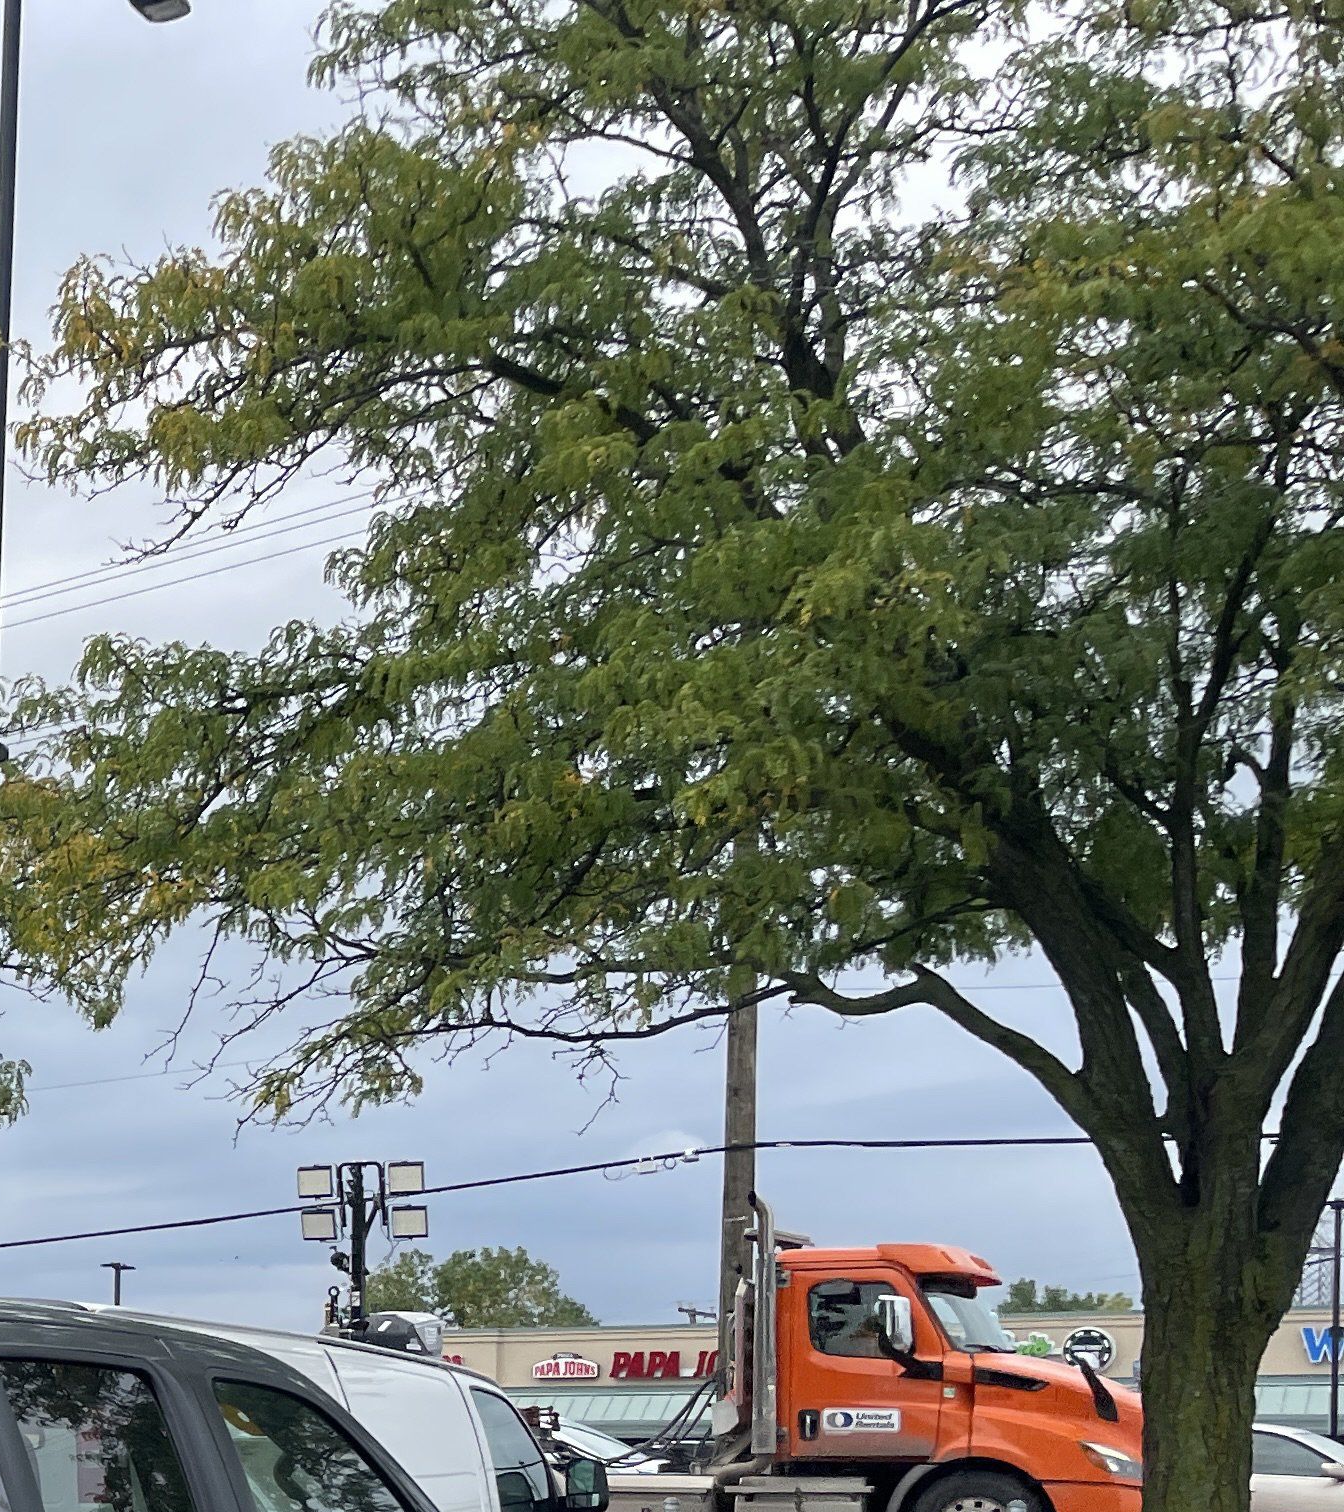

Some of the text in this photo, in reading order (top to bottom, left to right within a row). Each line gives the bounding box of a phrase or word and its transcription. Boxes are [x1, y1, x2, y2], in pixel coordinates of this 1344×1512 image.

[534, 1361, 561, 1377] PAPA
[609, 1350, 680, 1378] PAPA
[855, 1412, 893, 1421] United
[854, 1420, 895, 1429] Rentals
